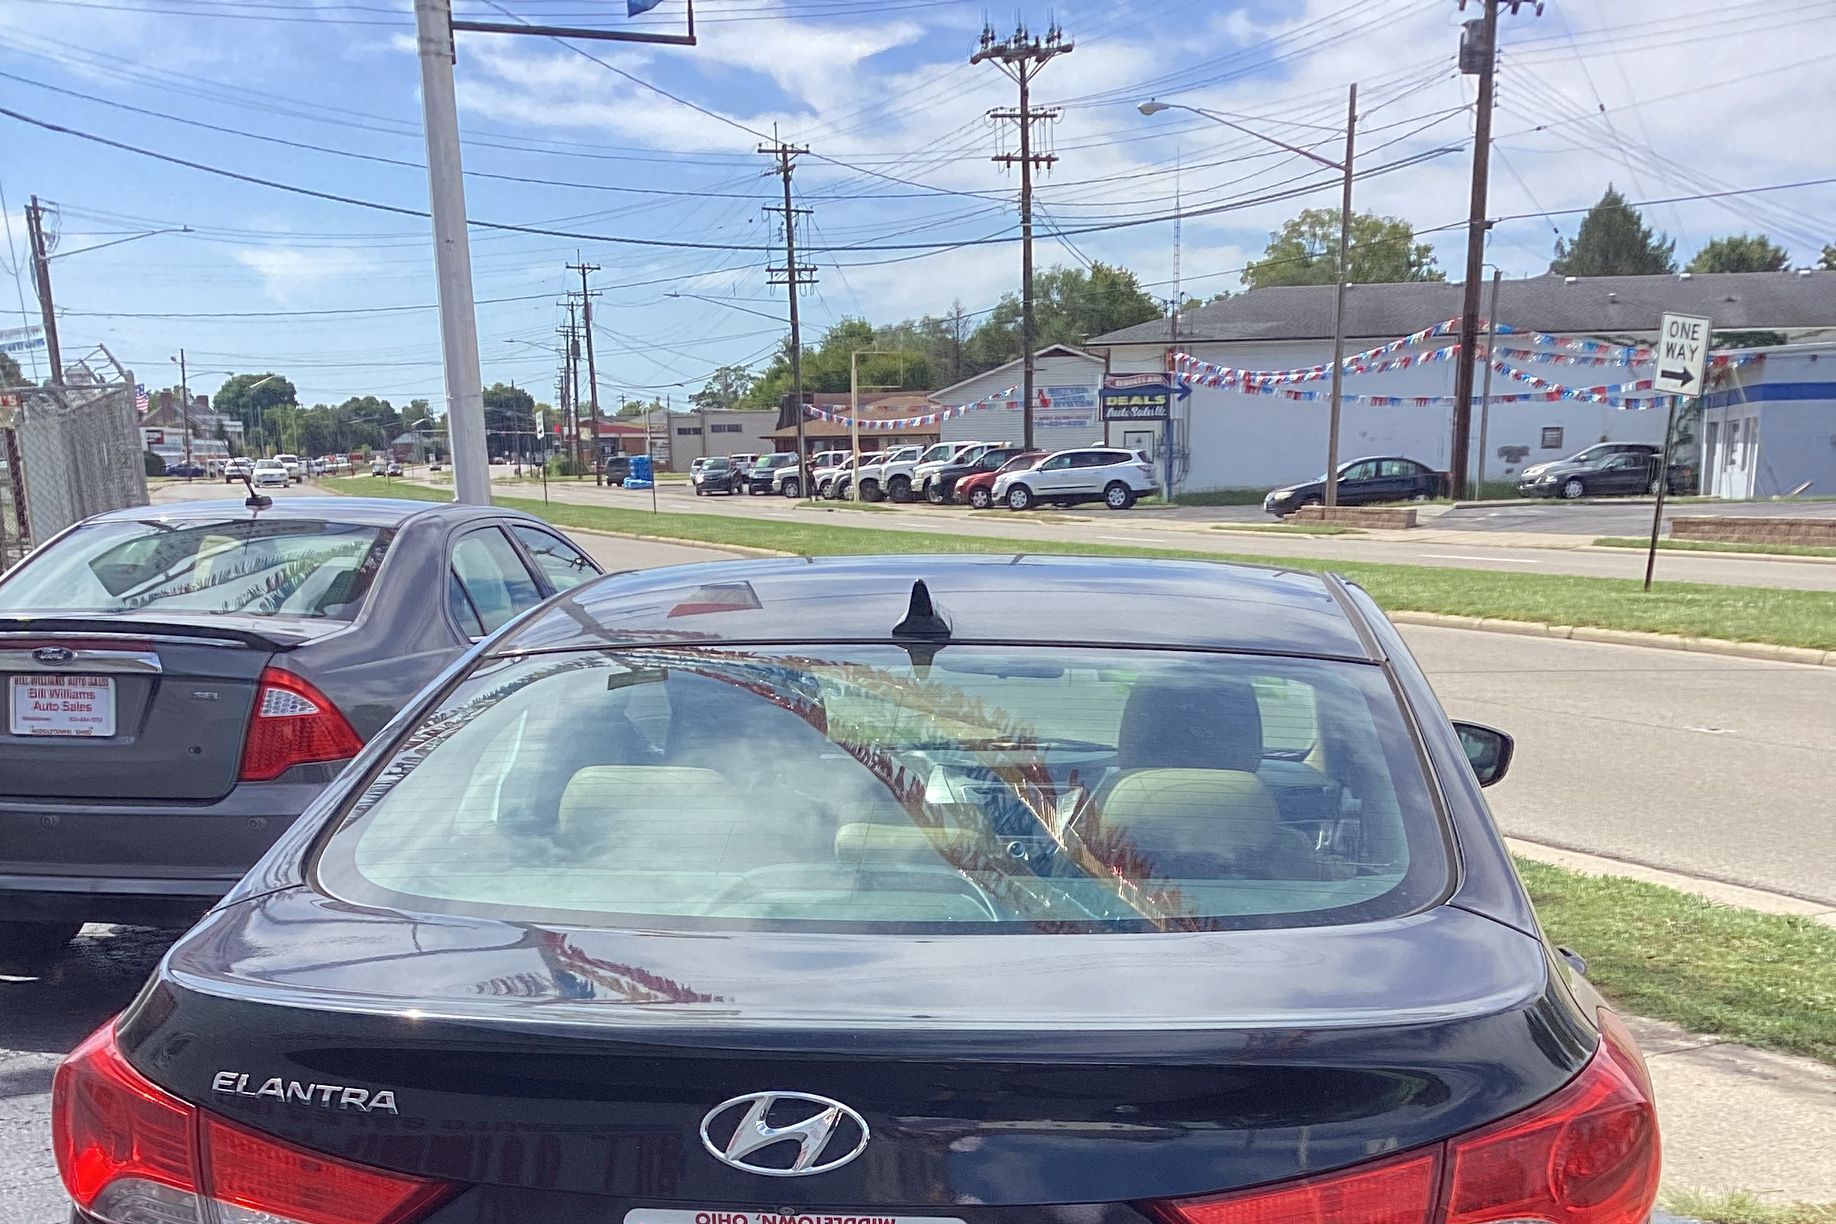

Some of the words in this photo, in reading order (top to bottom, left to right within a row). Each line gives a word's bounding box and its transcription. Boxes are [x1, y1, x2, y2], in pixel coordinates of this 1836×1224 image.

[1669, 321, 1701, 341] ONE
[1665, 341, 1699, 362] WAY
[1106, 395, 1167, 406] DEALS
[28, 688, 46, 699] Bill
[49, 688, 96, 700] Williams
[32, 701, 60, 712] Auto
[61, 701, 93, 713] Sales
[211, 1071, 399, 1115] ELANTRA
